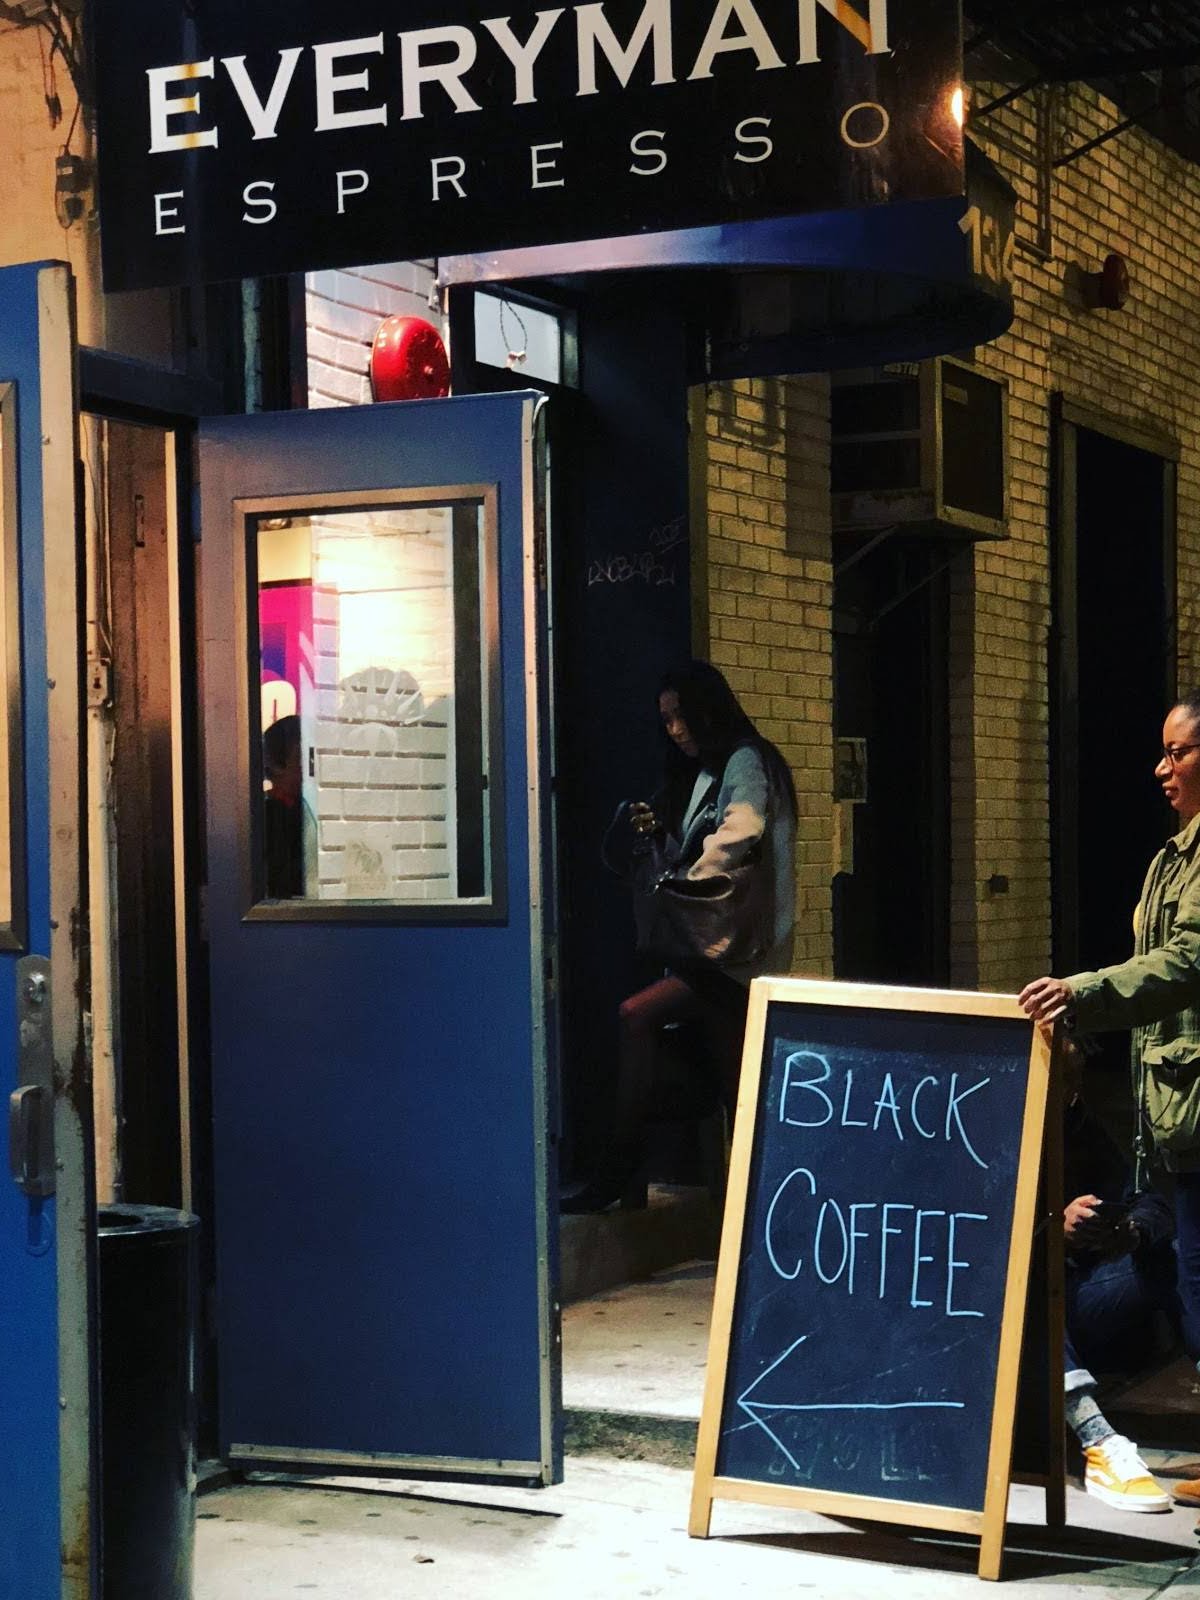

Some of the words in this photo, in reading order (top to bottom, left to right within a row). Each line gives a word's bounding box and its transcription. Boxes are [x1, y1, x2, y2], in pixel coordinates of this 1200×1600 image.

[146, 0, 892, 154] EVERYMAN
[154, 102, 890, 236] ESPRESSO
[778, 1050, 991, 1169] BLACK
[765, 1167, 989, 1317] COFFEE
